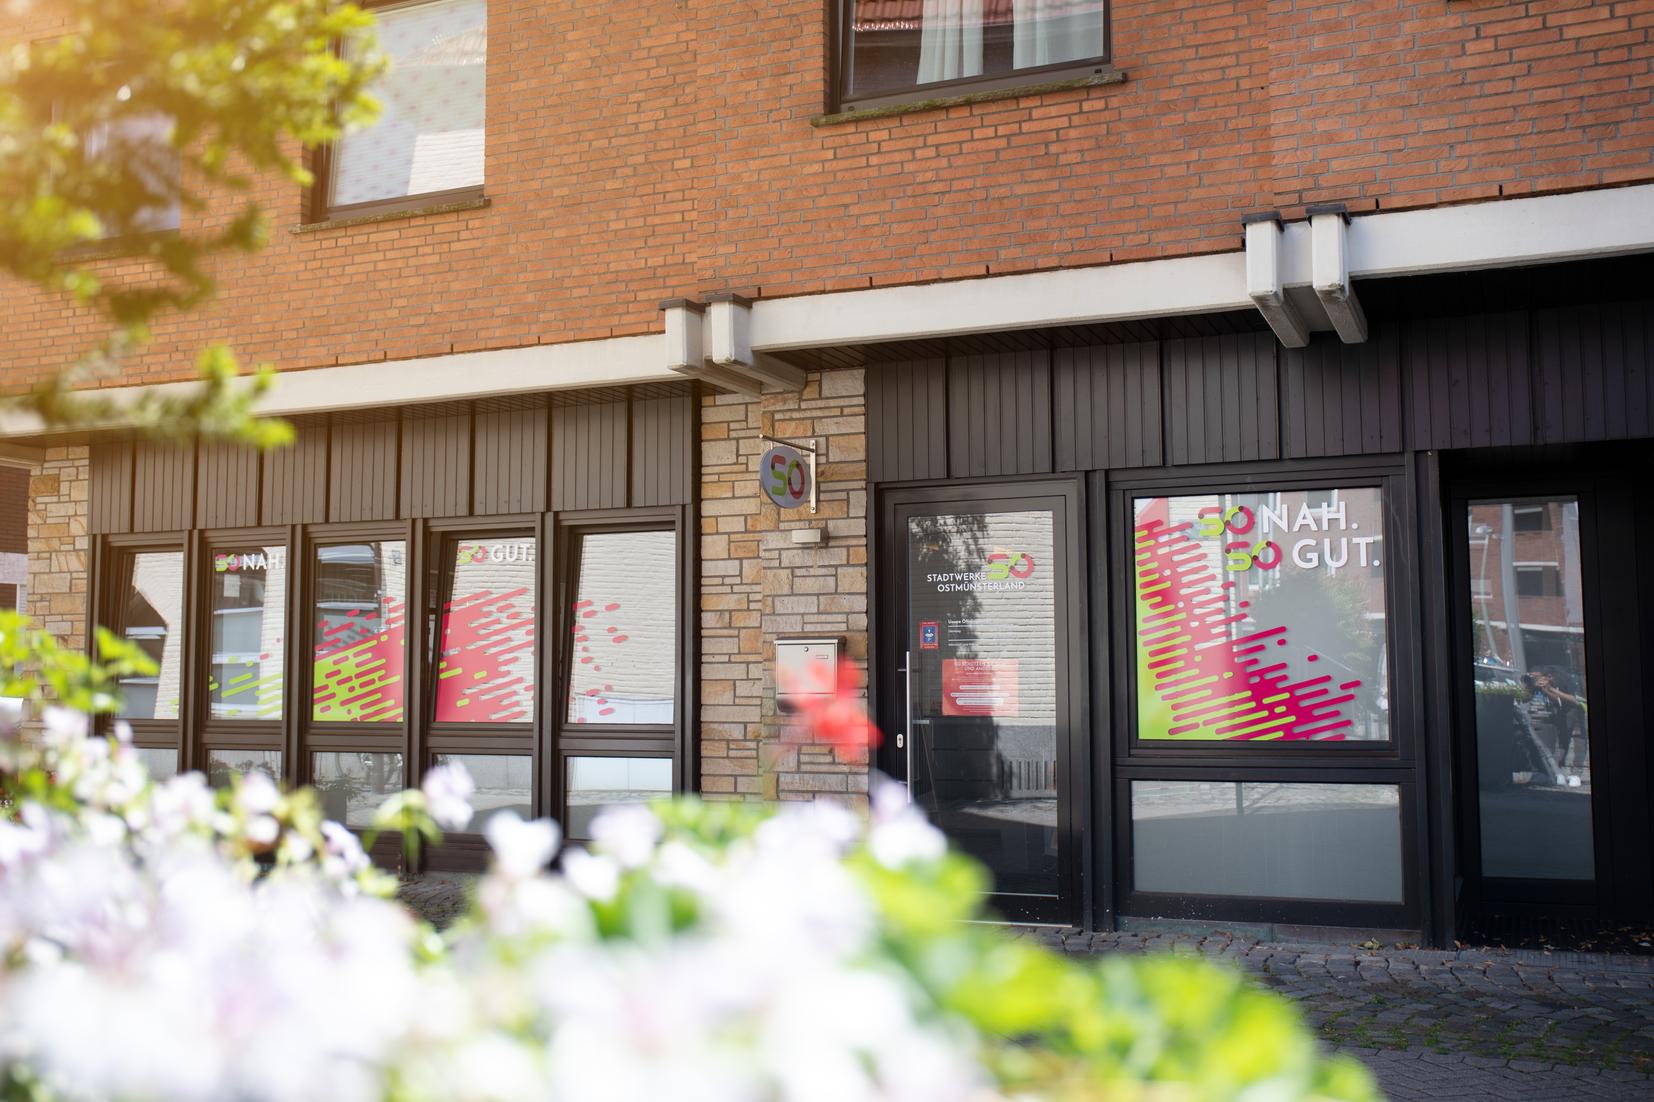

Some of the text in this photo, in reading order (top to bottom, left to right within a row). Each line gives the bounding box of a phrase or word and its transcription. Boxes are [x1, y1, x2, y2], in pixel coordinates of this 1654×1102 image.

[771, 454, 805, 500] SO
[1199, 501, 1360, 536] SO NAH.
[987, 552, 1035, 579] SO
[1225, 536, 1381, 571] SO GUT.
[927, 572, 987, 583] STADTWERKE
[937, 581, 1025, 593] OSTMÜNSTERLAND
